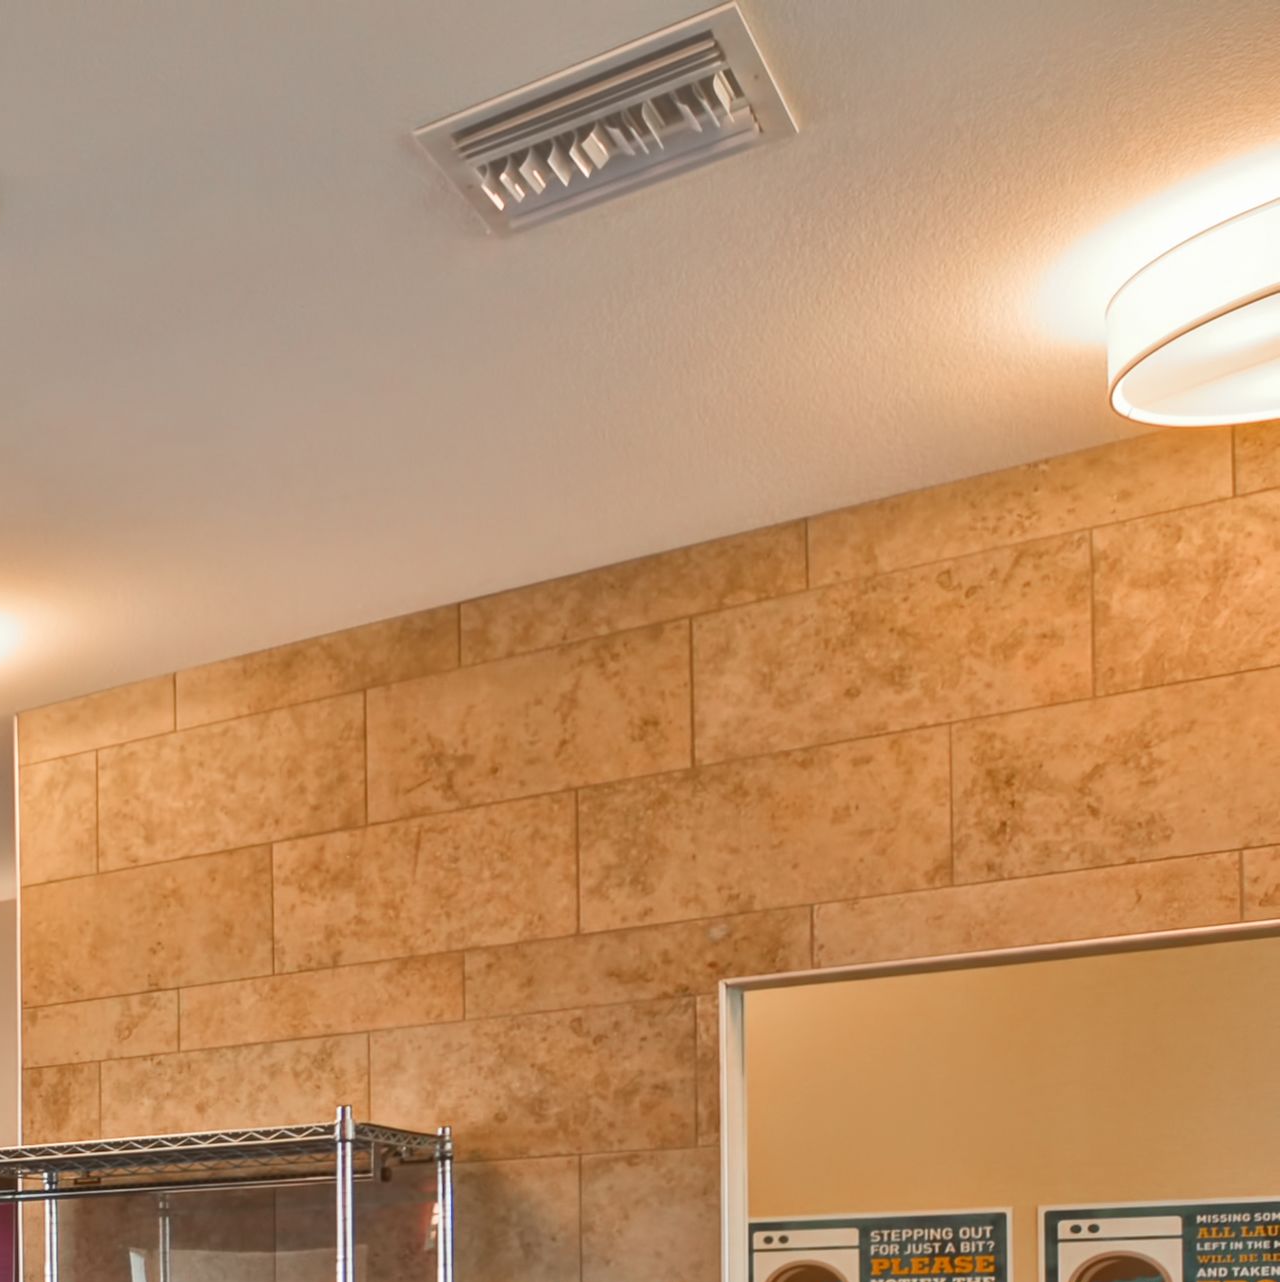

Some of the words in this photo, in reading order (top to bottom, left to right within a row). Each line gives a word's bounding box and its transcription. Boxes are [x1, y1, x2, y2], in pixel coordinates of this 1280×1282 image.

[1196, 1213, 1251, 1224] MISSING
[870, 1227, 953, 1242] STEPPING
[959, 1226, 993, 1239] OUT
[1197, 1226, 1236, 1239] ALL
[1241, 1224, 1280, 1238] LAU
[870, 1243, 899, 1255] FOR
[904, 1242, 941, 1255] JUST
[945, 1242, 956, 1253] A
[960, 1240, 995, 1253] BIT?
[1196, 1241, 1227, 1251] LEFT
[1230, 1241, 1243, 1250] IN
[1247, 1240, 1271, 1249] THE
[870, 1255, 995, 1276] PLEASE
[1197, 1254, 1235, 1264] WILL
[1239, 1253, 1258, 1263] BE
[1197, 1267, 1228, 1278] AND
[1232, 1265, 1280, 1277] TAKEN
